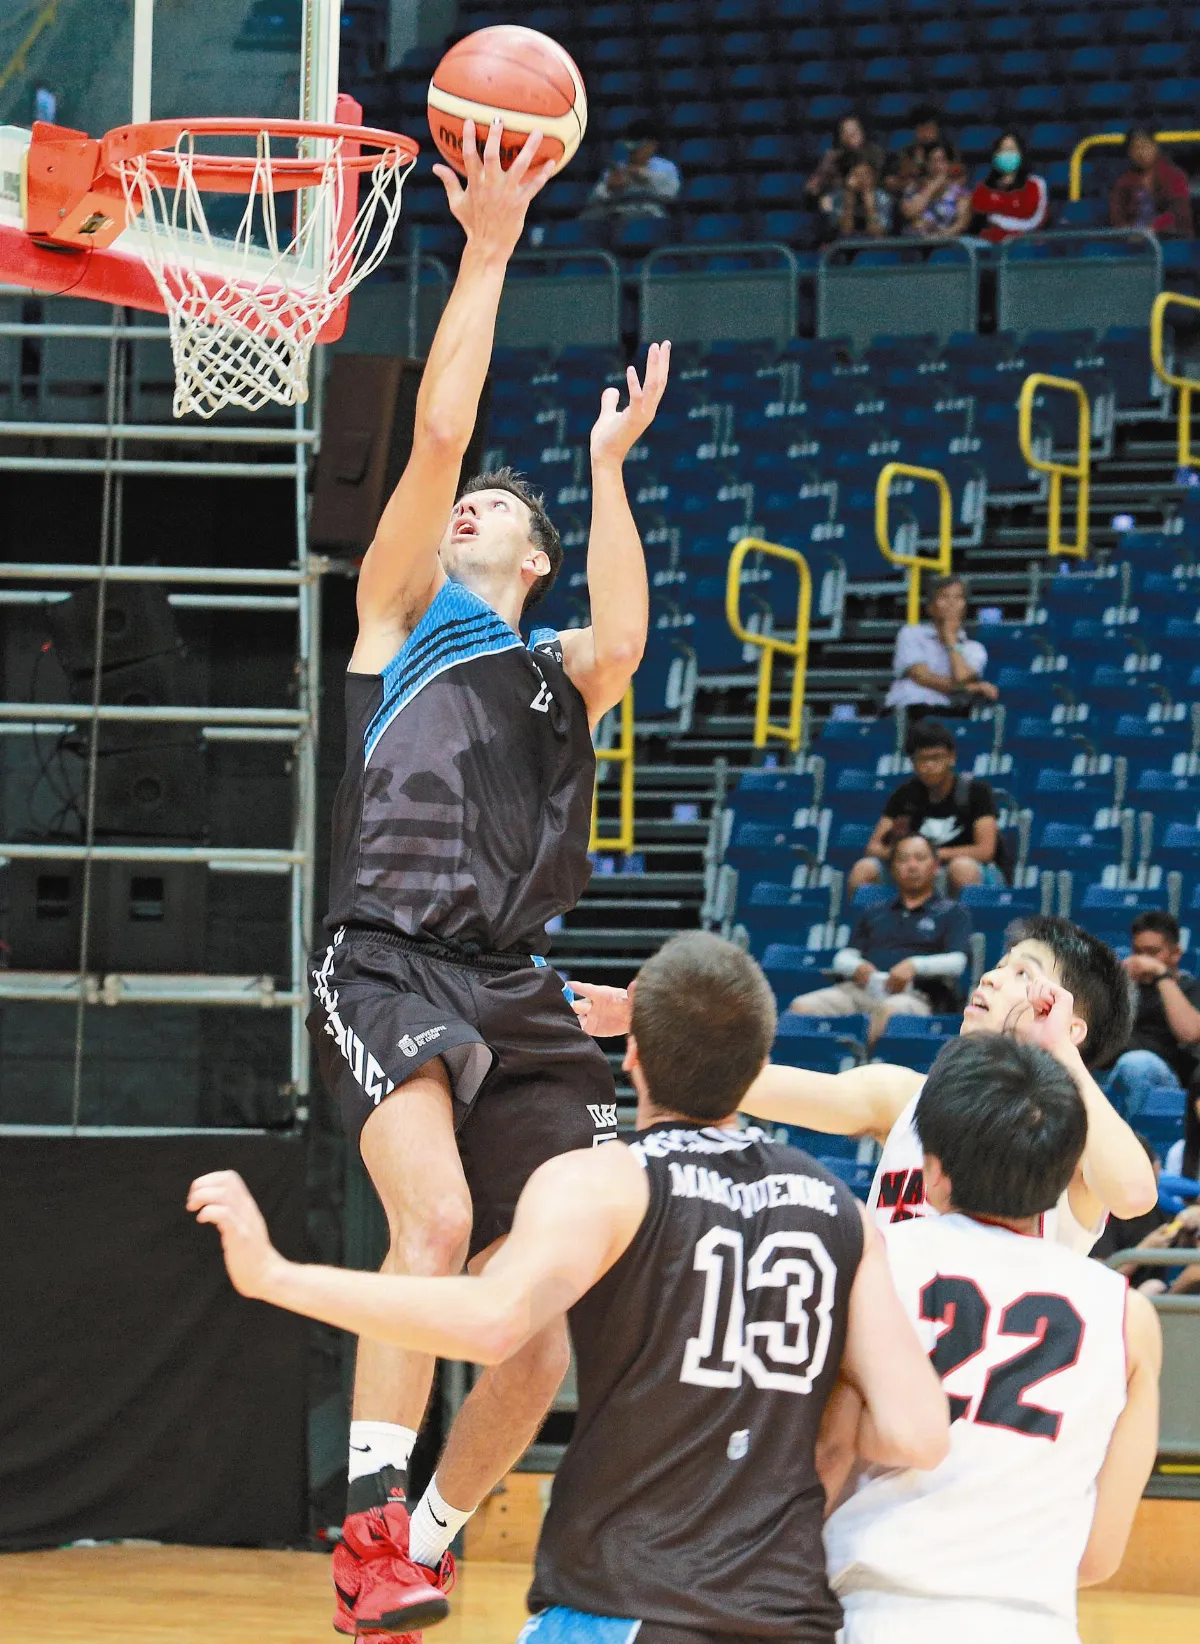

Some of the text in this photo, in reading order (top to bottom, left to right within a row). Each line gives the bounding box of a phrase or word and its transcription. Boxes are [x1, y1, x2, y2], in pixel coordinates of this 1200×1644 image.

[416, 1032, 441, 1047] DE LYON
[678, 1225, 838, 1395] 13
[918, 1271, 1086, 1442] 22
